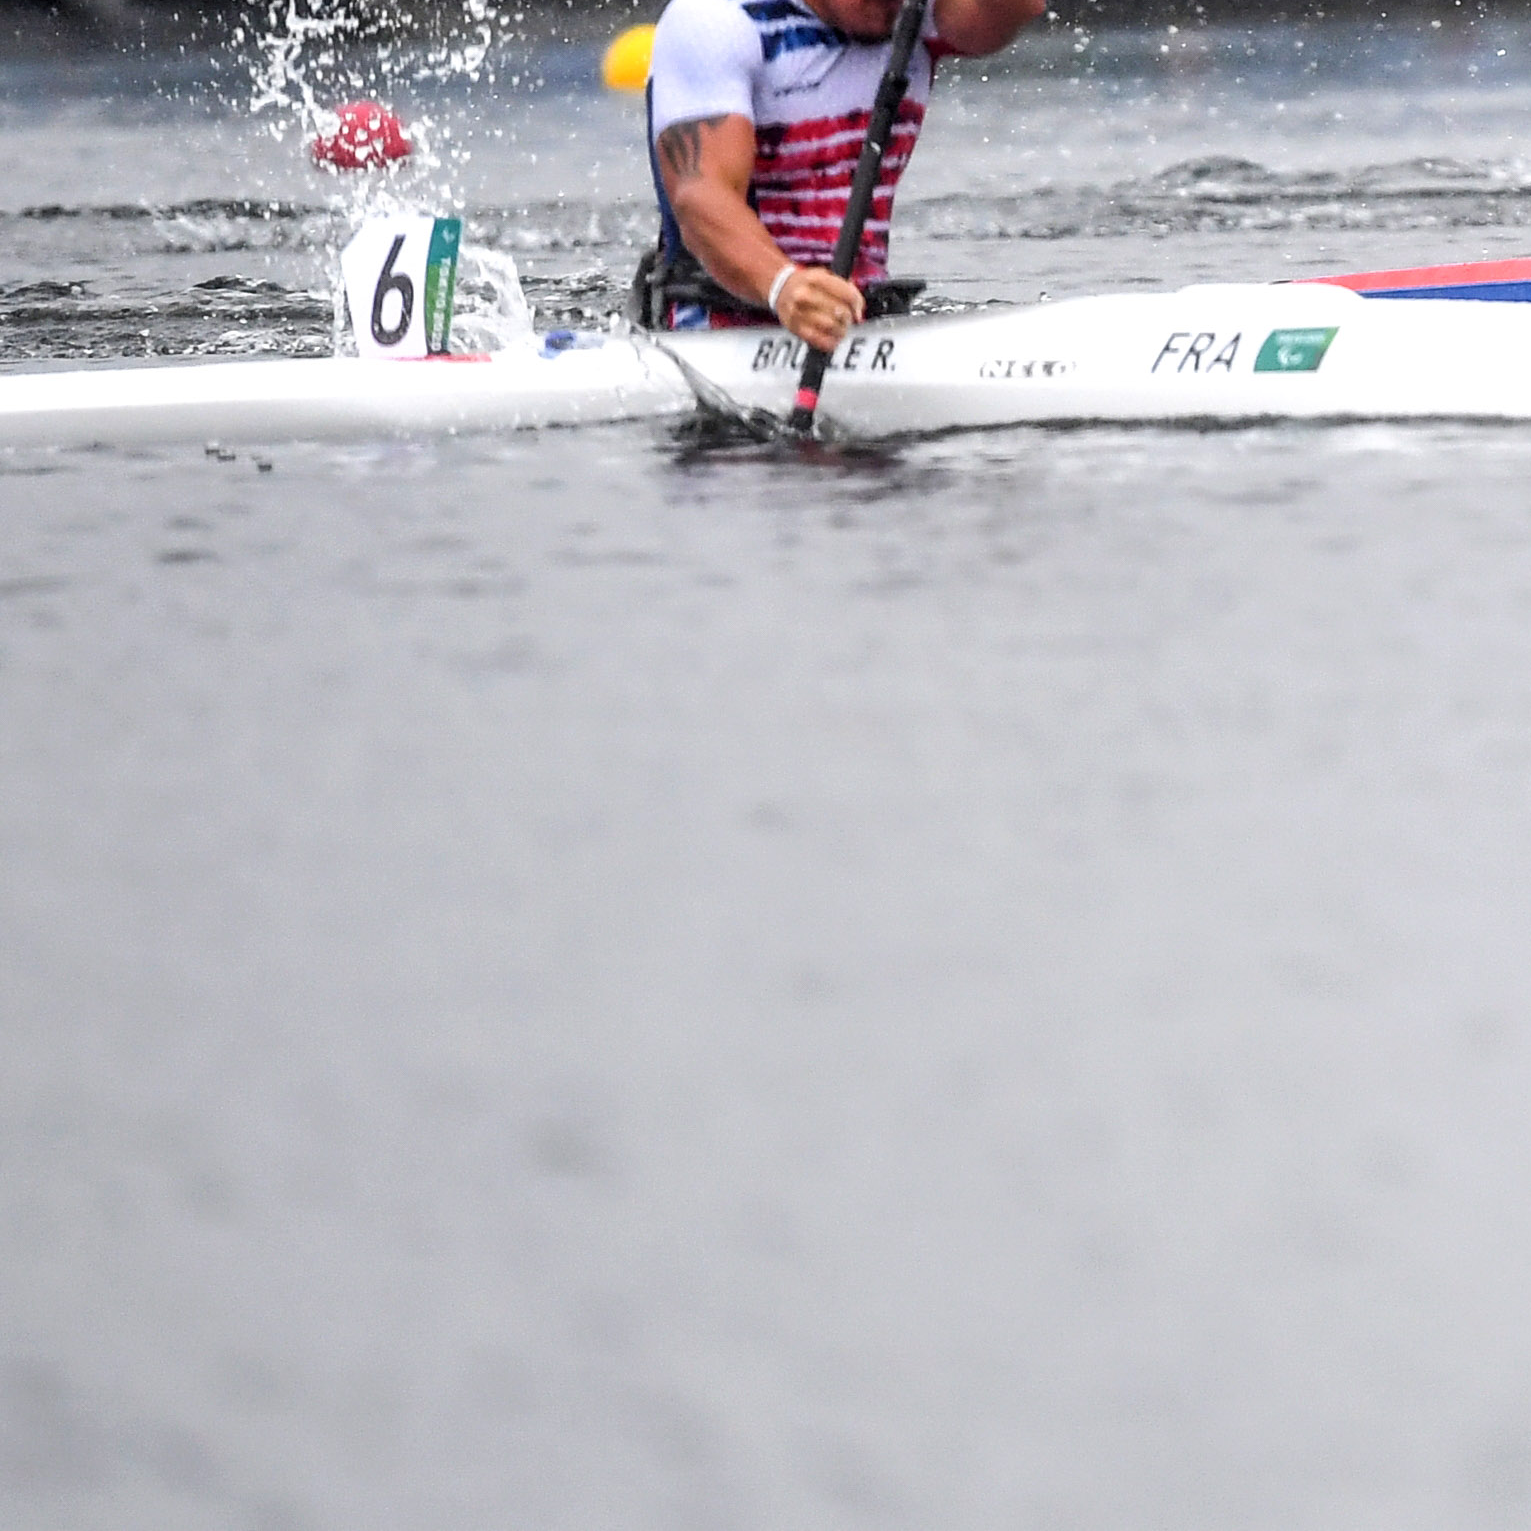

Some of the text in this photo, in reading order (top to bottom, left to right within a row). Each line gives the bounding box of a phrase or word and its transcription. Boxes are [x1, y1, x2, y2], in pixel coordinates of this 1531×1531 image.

[371, 234, 414, 346] 6
[871, 338, 896, 371] R.
[1151, 332, 1242, 373] FRA
